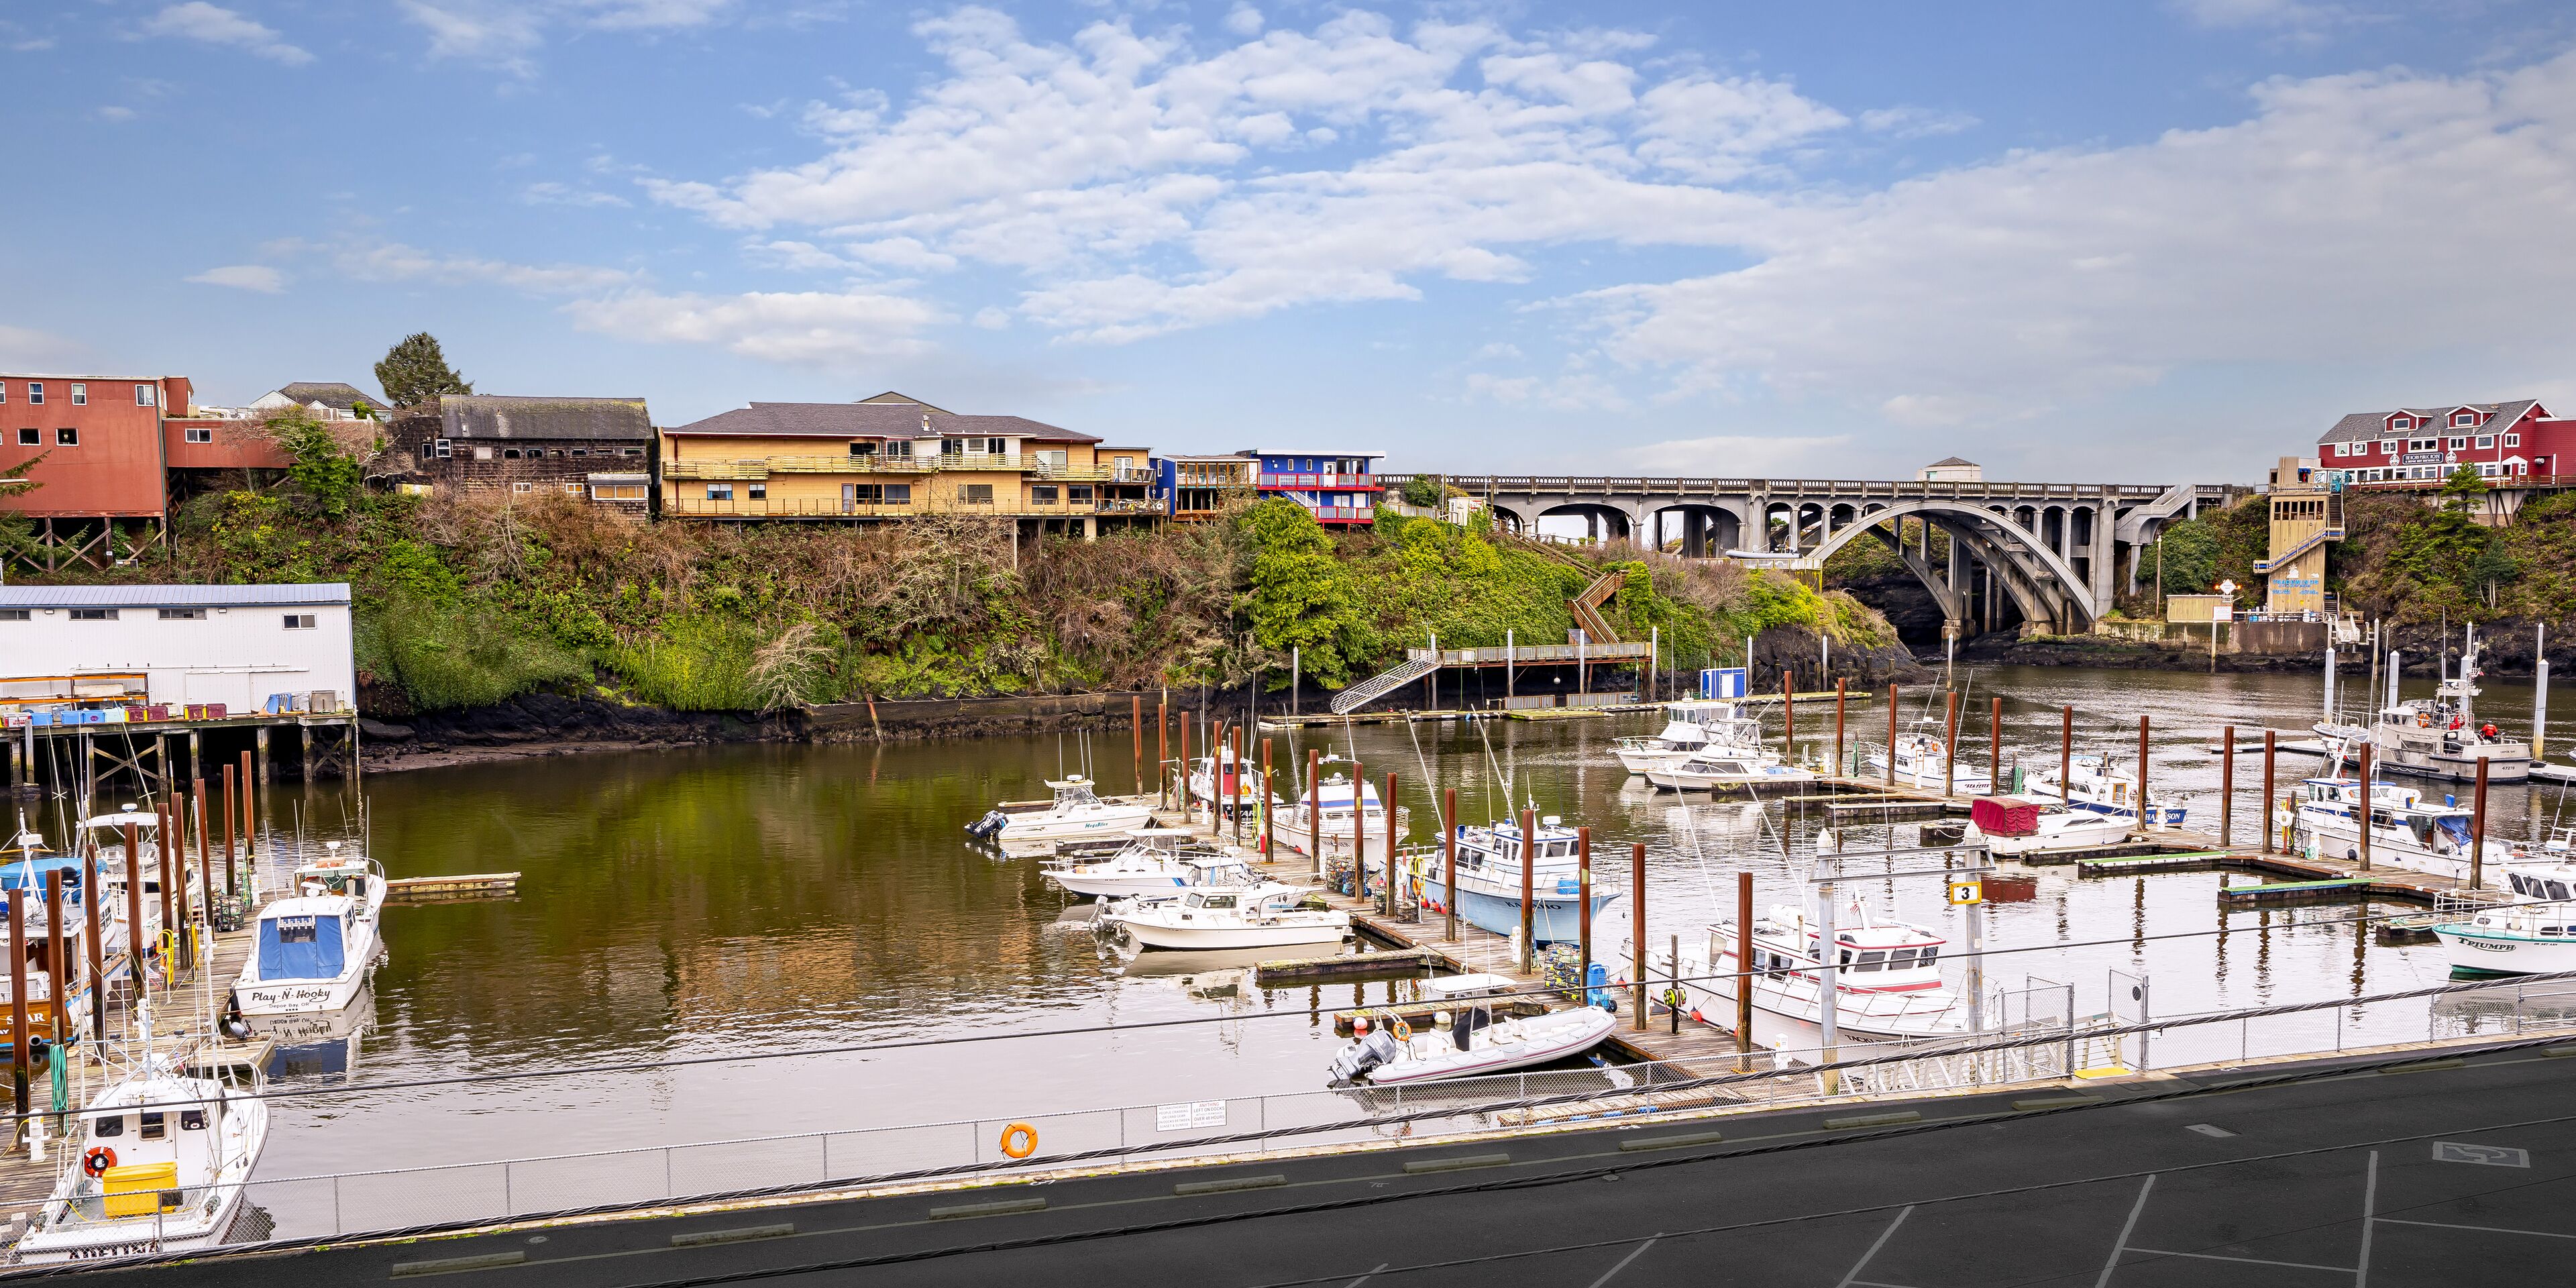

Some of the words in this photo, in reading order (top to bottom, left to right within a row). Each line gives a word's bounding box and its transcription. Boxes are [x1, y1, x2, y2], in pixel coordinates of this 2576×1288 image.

[1962, 887, 1970, 900] 3
[2458, 937, 2516, 950] TRIUMPH
[7, 1013, 46, 1025] SAR
